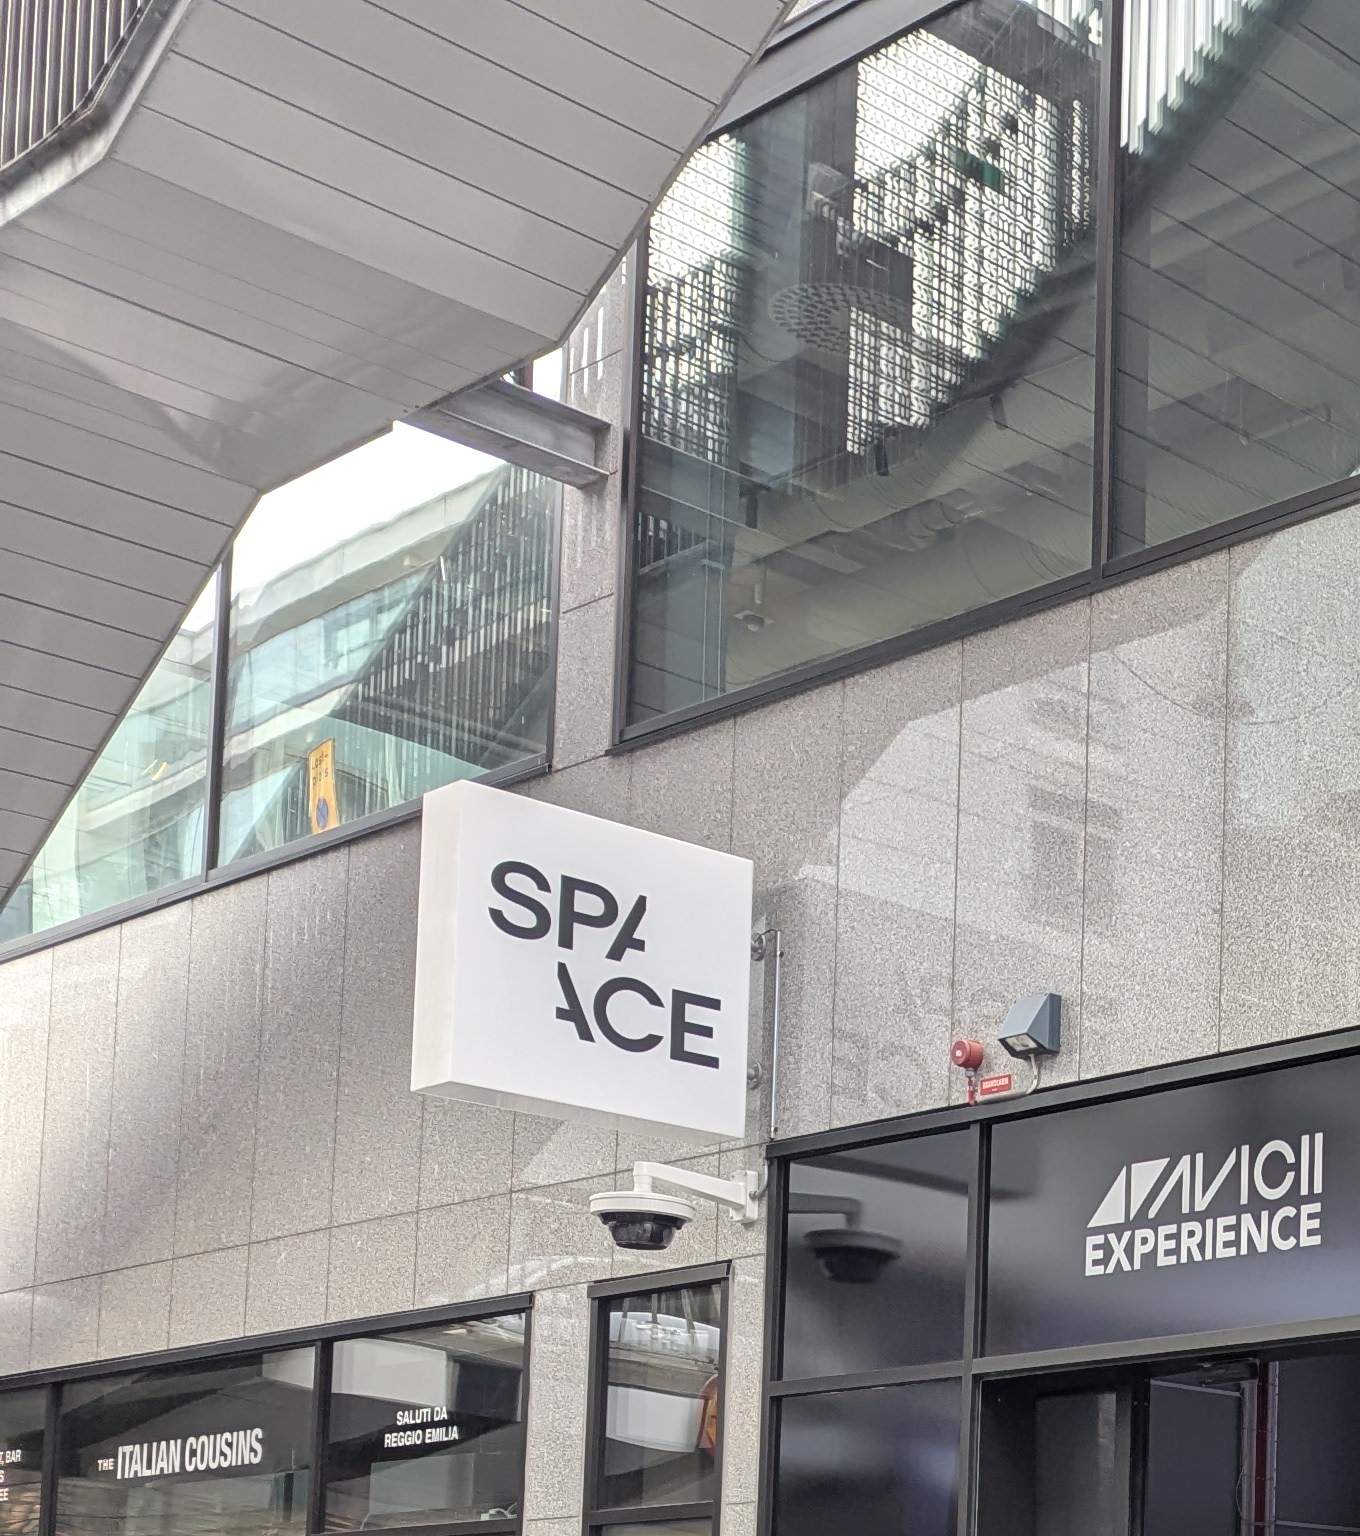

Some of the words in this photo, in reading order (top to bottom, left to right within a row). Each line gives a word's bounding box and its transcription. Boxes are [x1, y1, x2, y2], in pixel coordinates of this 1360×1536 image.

[1148, 1132, 1323, 1219] AVICII
[1085, 1202, 1321, 1276] EXPERIENCE
[384, 1433, 423, 1448] REGGIO
[424, 1425, 459, 1443] EMILIA
[396, 1411, 431, 1426] SALUTI
[433, 1406, 448, 1421] DA
[97, 1459, 114, 1471] THE
[117, 1439, 182, 1479] ITALIAN
[184, 1428, 263, 1471] COUSINS
